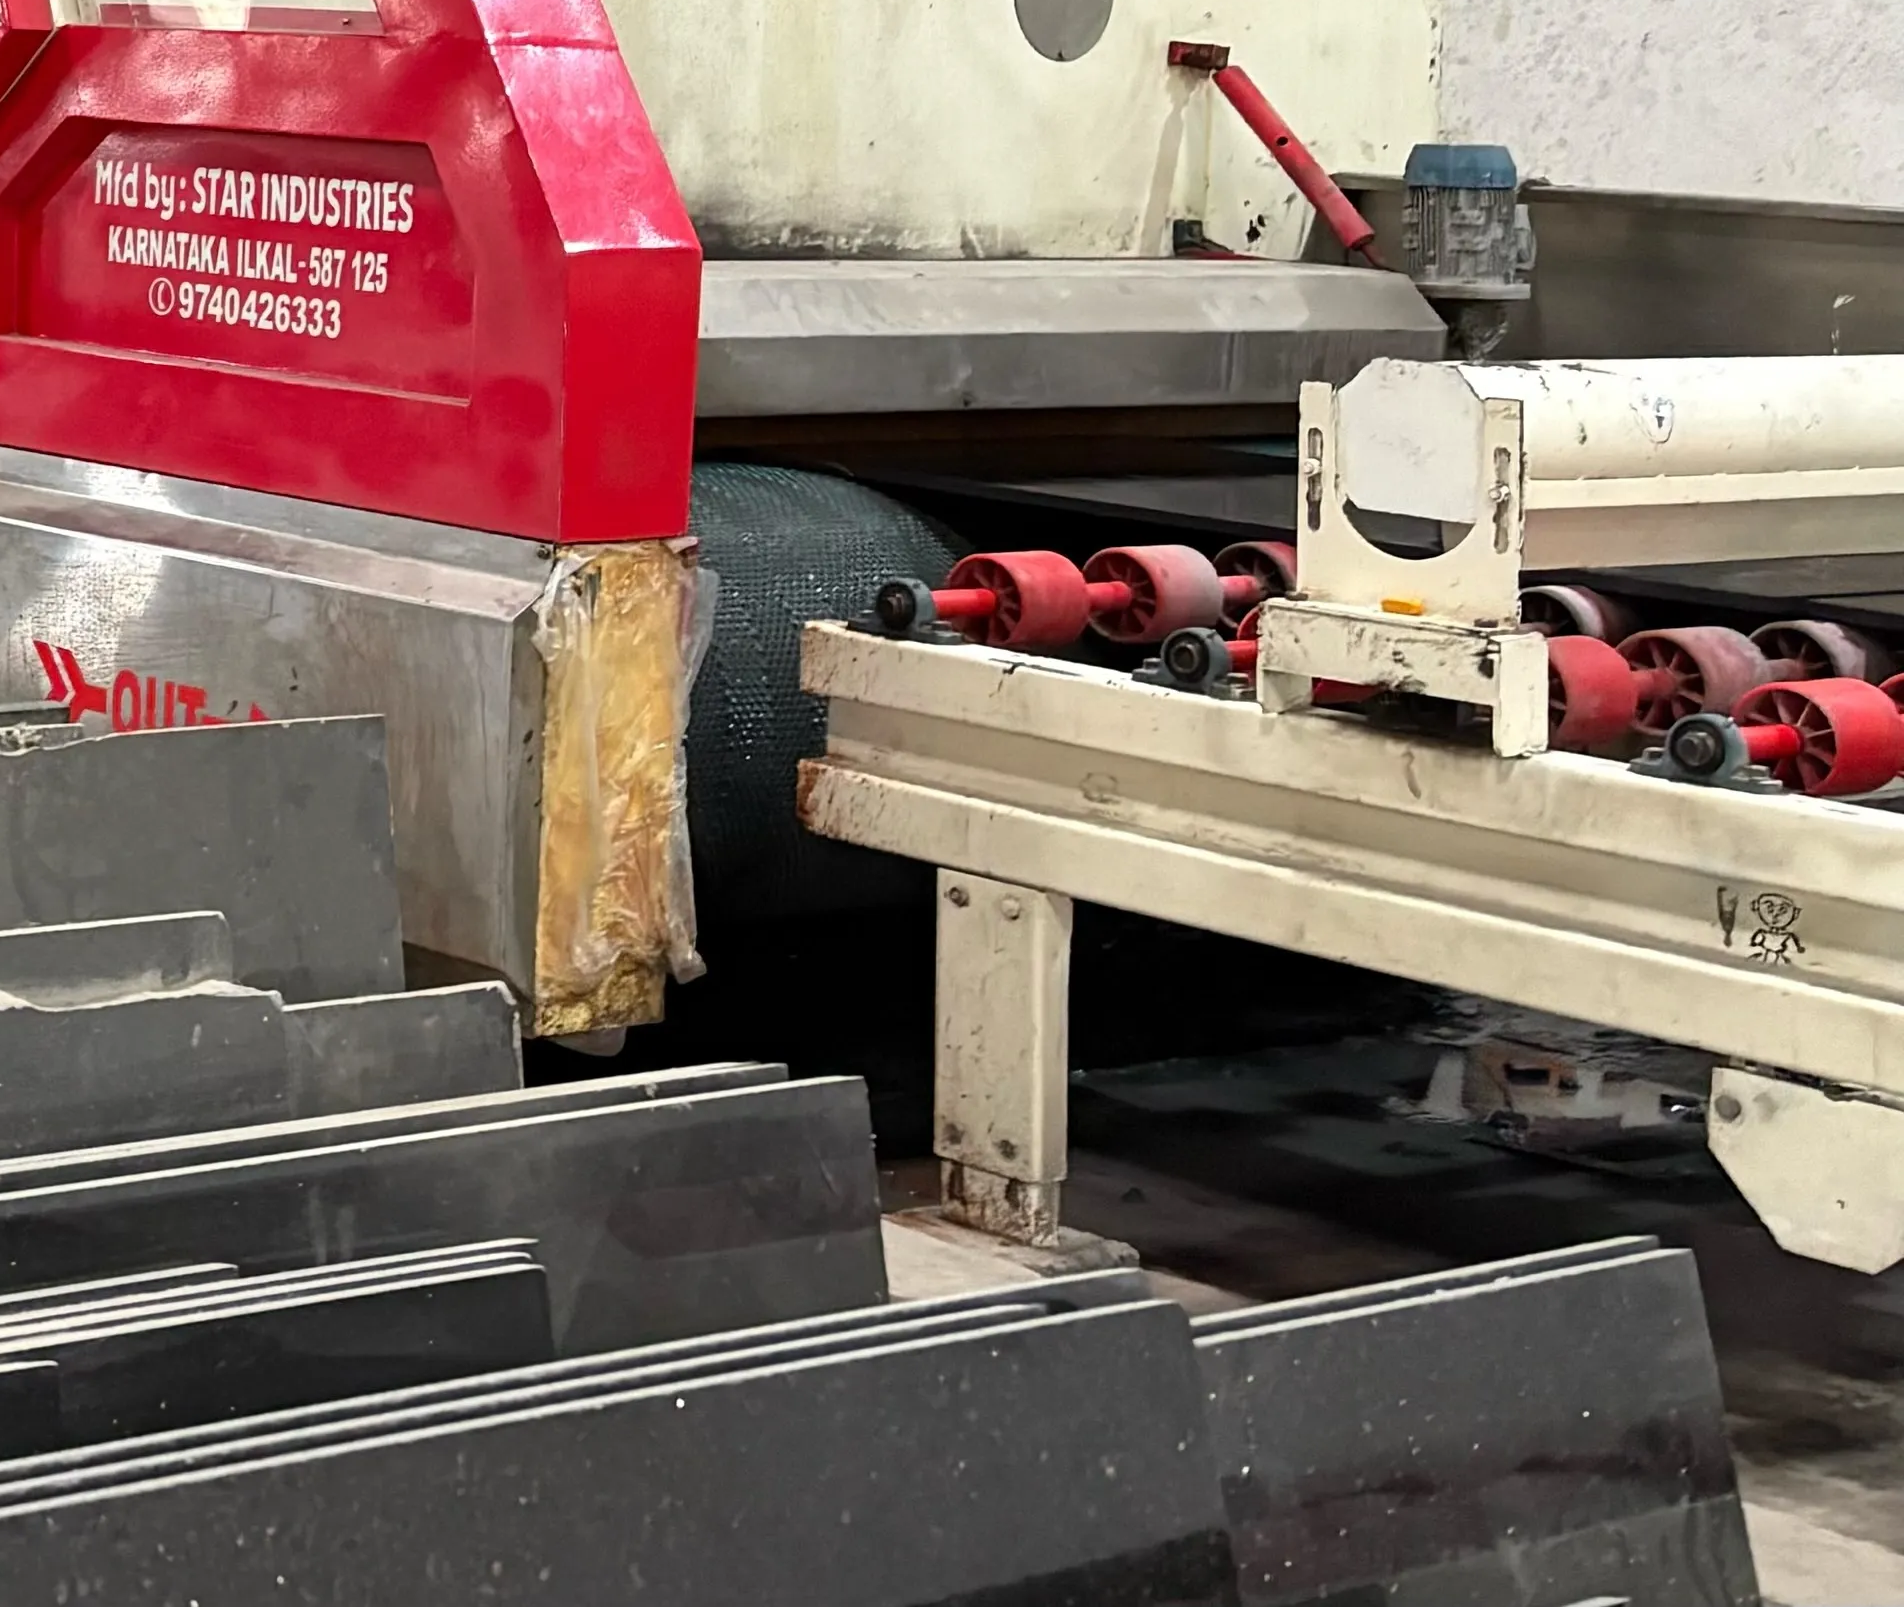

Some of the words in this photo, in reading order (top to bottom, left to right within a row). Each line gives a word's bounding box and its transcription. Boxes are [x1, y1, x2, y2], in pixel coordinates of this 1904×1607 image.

[95, 159, 139, 208] Mfd
[191, 166, 256, 220] STAR
[261, 172, 415, 234] INDUSTRIES
[107, 225, 230, 277] KARNATAKA
[351, 250, 389, 294] 125
[178, 281, 342, 340] 9740426333
[112, 668, 208, 733] OUT
